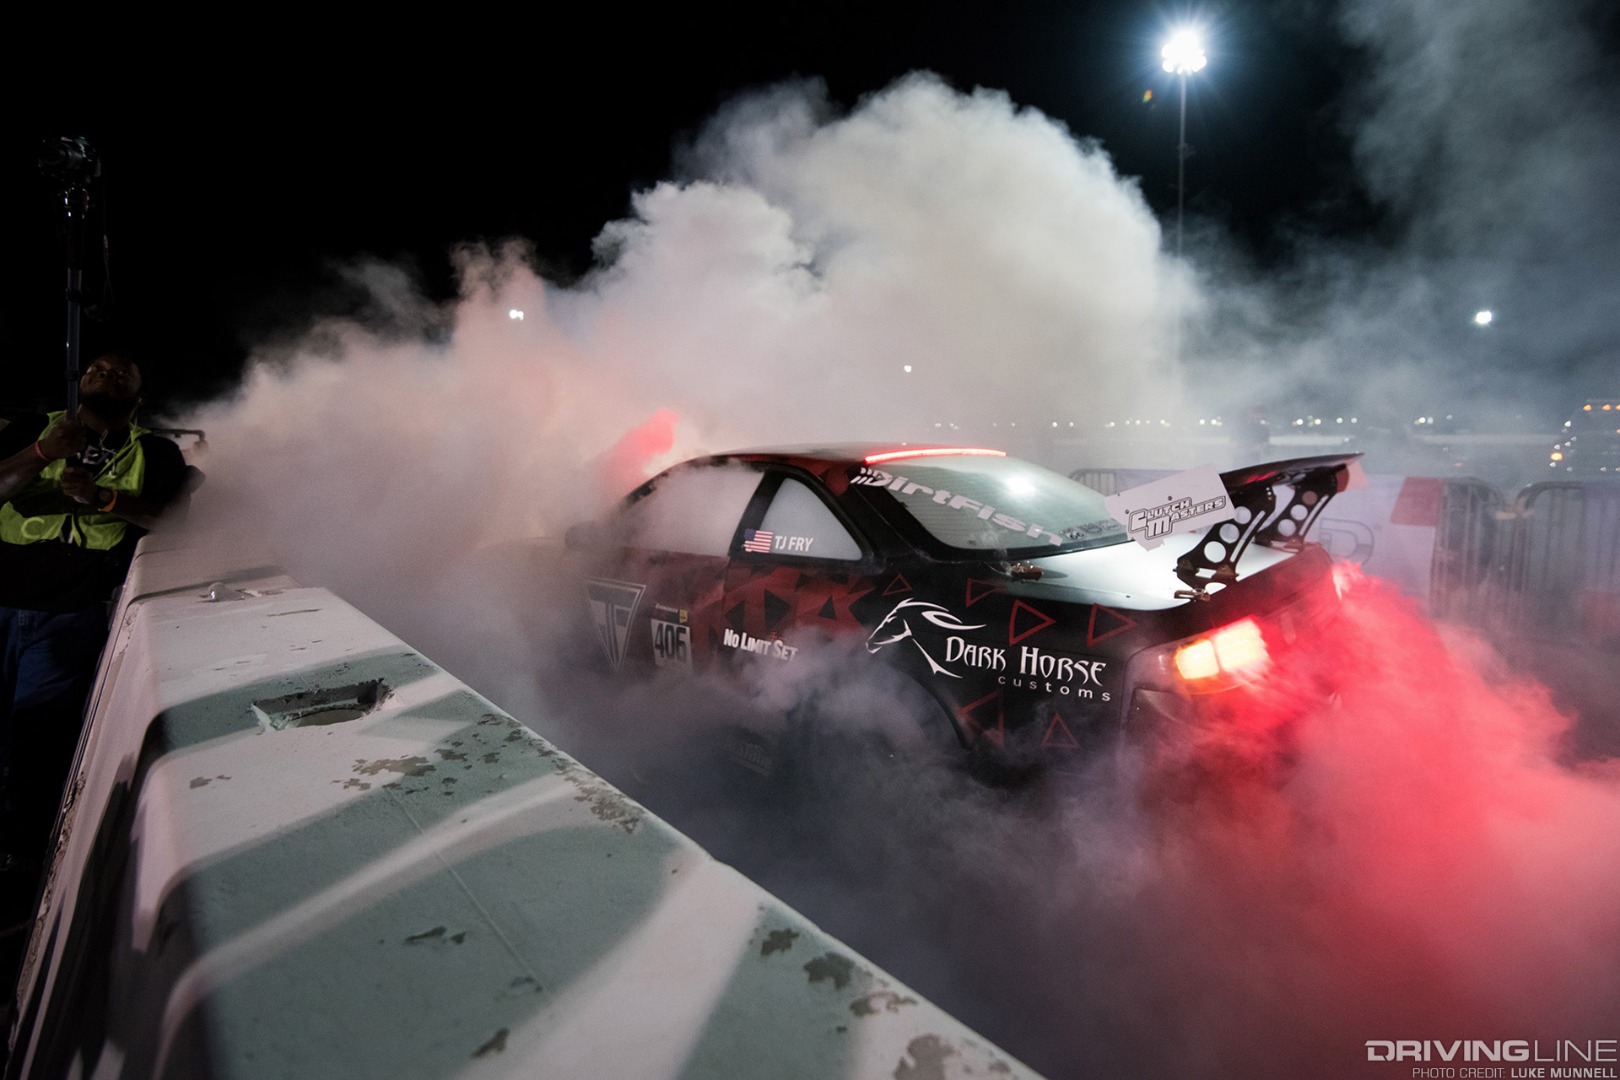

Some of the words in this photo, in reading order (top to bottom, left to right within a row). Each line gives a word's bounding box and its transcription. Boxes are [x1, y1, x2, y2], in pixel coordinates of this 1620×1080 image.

[1129, 496, 1192, 533] CLUTCH
[1146, 496, 1226, 538] MASTERS
[775, 535, 788, 549] TJ
[789, 536, 813, 551] FRY
[655, 622, 688, 663] 406
[945, 635, 1006, 671] DARK
[1020, 645, 1107, 686] HORSE
[997, 675, 1112, 702] customs
